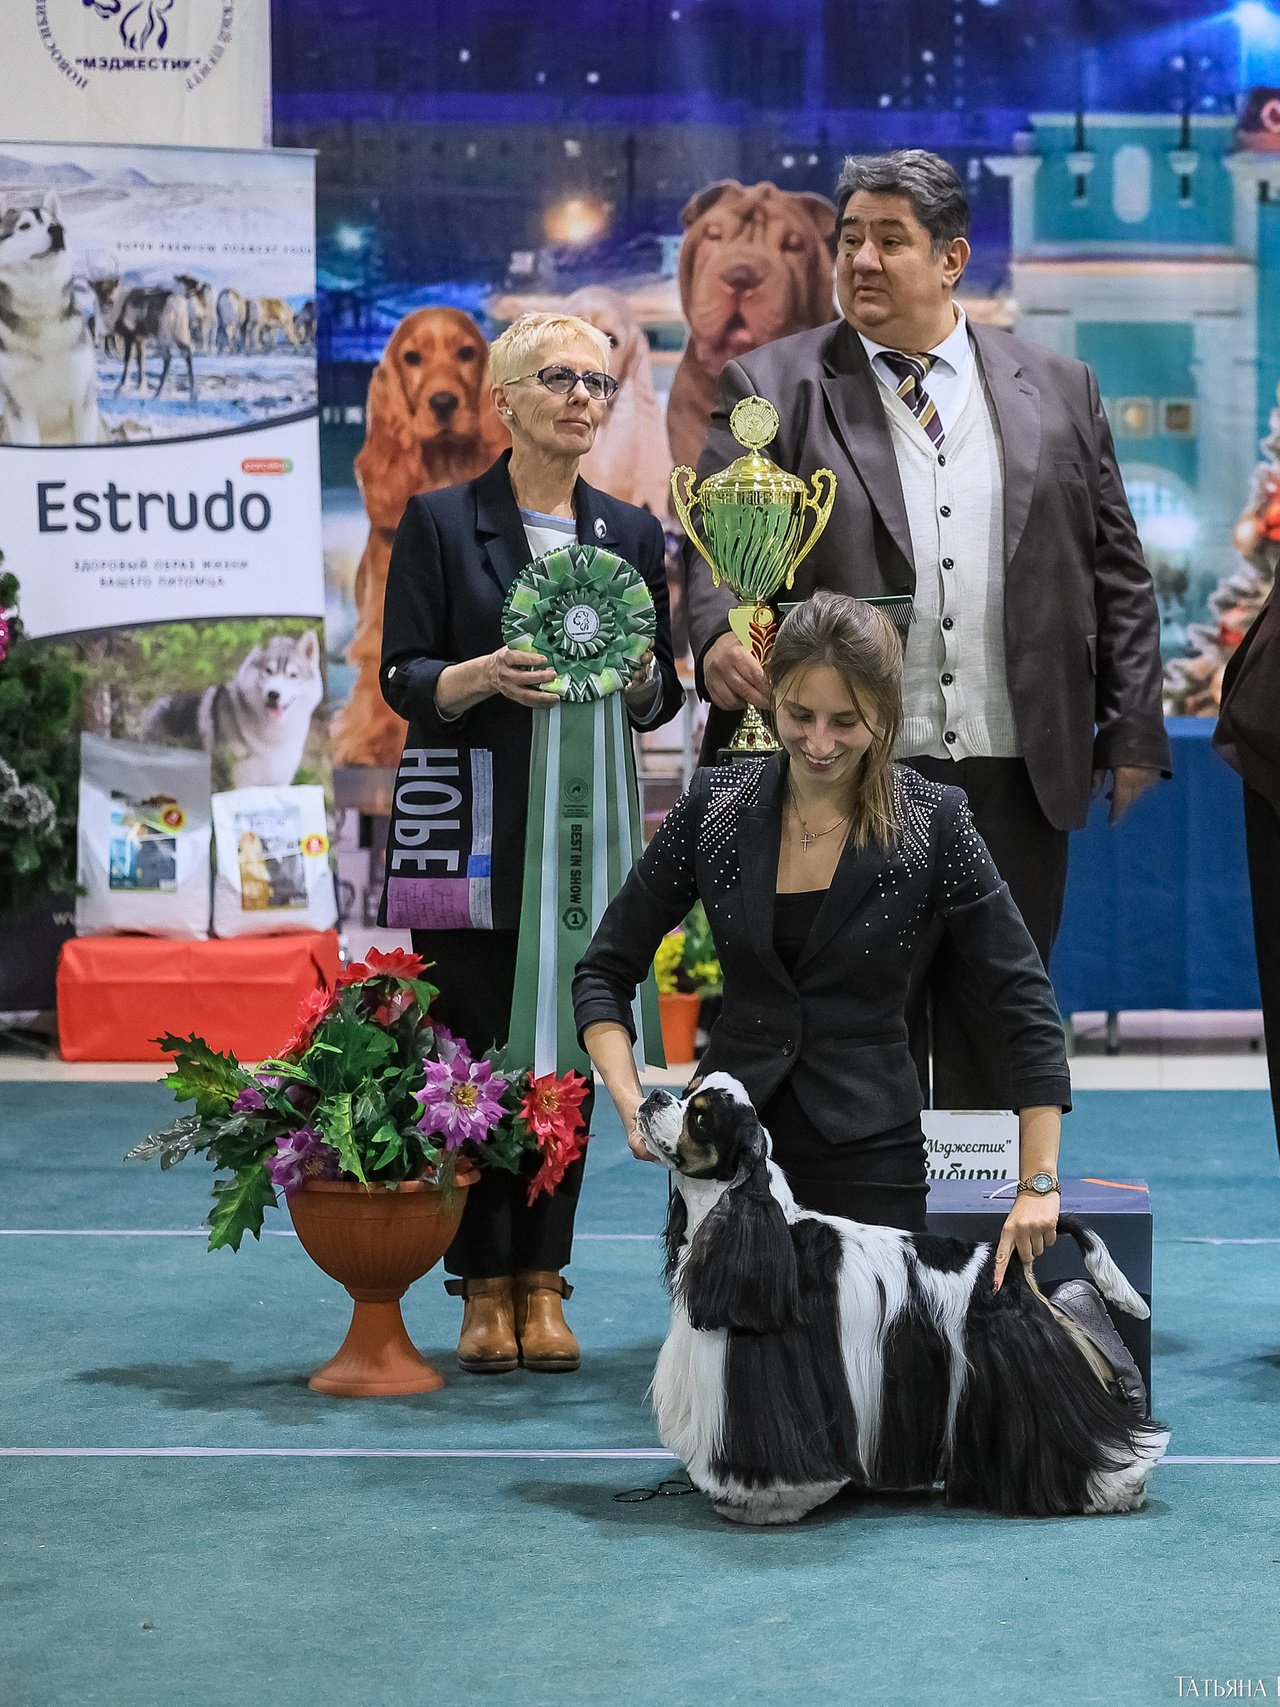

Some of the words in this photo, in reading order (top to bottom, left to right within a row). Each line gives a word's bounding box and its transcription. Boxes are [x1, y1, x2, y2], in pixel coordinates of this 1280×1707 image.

[37, 478, 271, 532] Estrudo
[74, 559, 148, 571] ЗДОРОВЫЙ
[154, 559, 196, 571] ОБРАЗ
[202, 559, 248, 570] ЖИЗНИ
[99, 576, 151, 588] ВАШЕГО
[158, 577, 225, 588] ПИТОМЦА
[570, 824, 583, 851] BEST
[570, 855, 582, 867] IN
[569, 869, 582, 904] SHOW
[571, 913, 580, 925] 1
